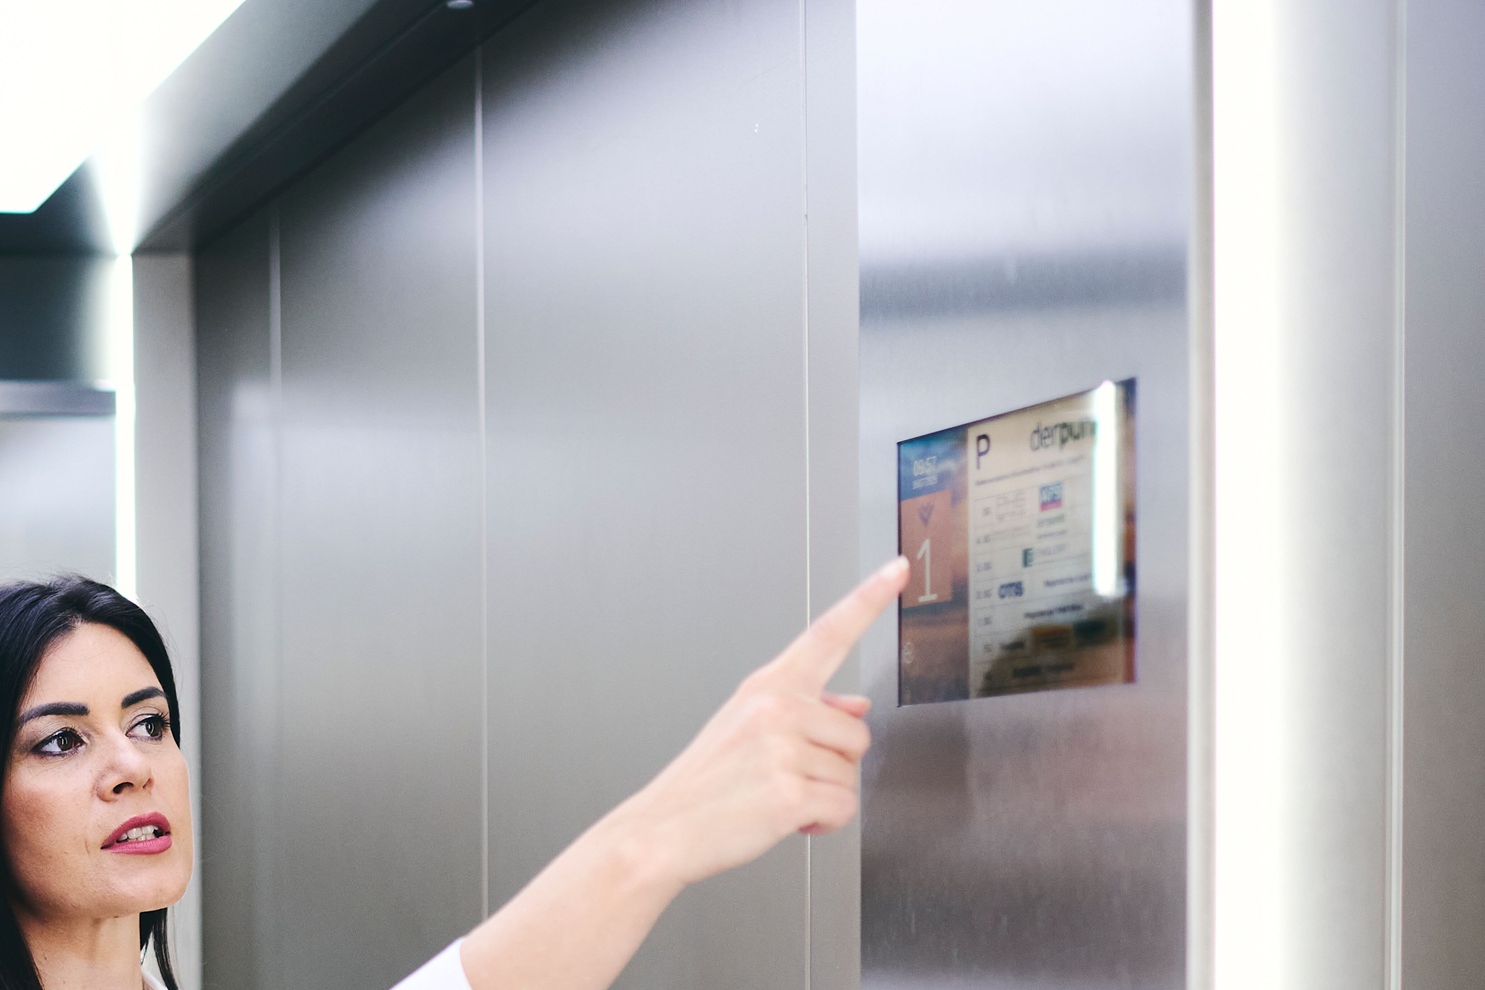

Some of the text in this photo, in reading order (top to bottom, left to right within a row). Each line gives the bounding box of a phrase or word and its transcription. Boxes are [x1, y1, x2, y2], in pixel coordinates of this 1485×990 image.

[976, 418, 1097, 470] P derpun
[917, 538, 938, 602] 1
